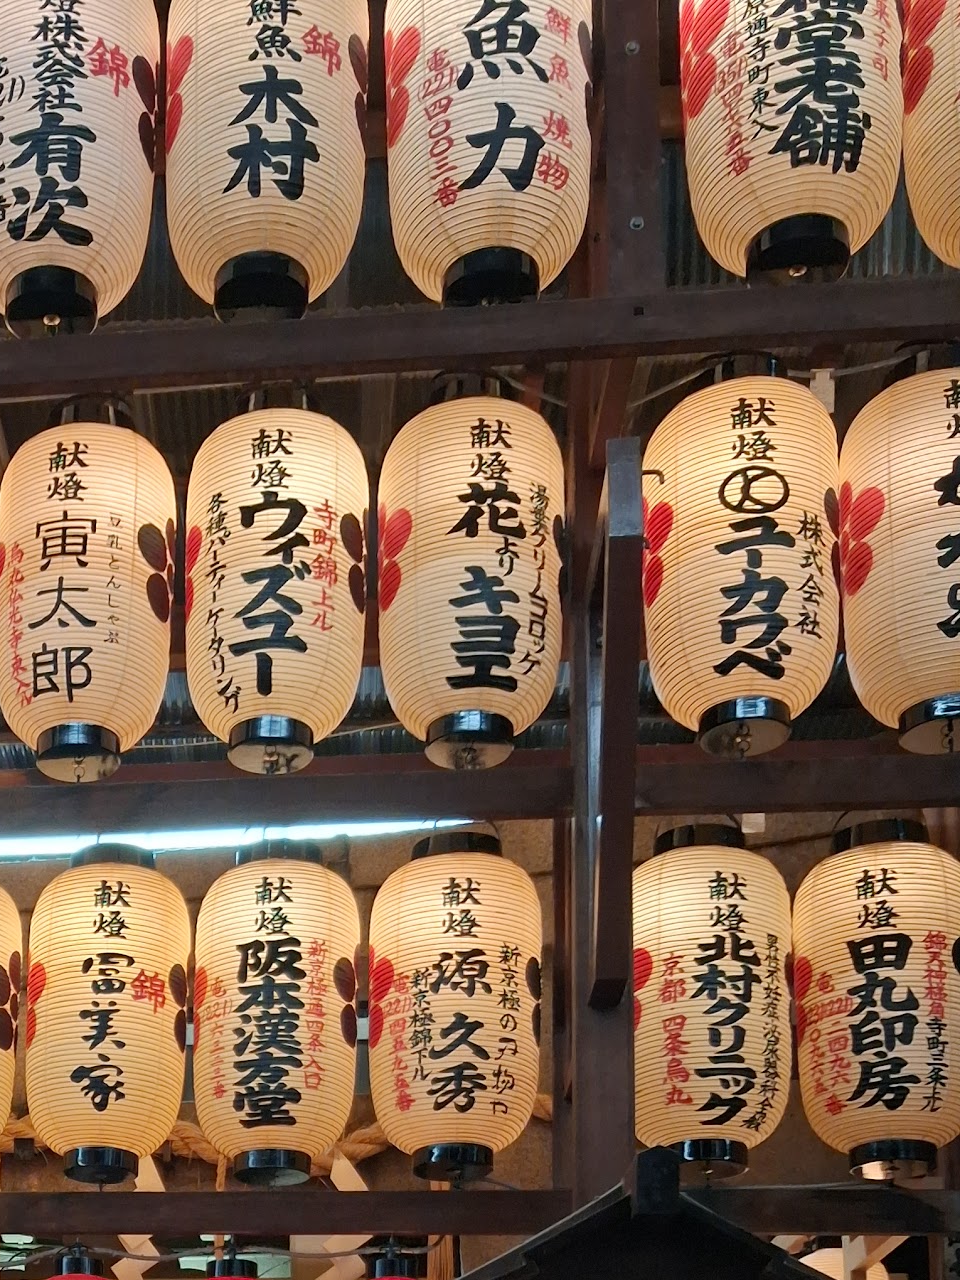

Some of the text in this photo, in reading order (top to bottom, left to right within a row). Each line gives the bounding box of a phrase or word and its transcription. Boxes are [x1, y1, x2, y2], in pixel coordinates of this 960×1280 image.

[29, 15, 89, 113] 株式会社
[84, 36, 132, 97] 錦
[300, 24, 343, 79] 錦
[457, 0, 551, 192] 魚力
[6, 113, 97, 248] 有次
[222, 64, 321, 201] 木村
[46, 441, 89, 502] 献燈
[250, 428, 294, 489] 献燈
[470, 417, 513, 483] 献燈
[730, 397, 779, 462] 献燈
[28, 510, 97, 703] 寅太郎
[103, 511, 123, 645] 豆乳とんしゃぶ
[204, 492, 241, 714] 各種パーティーケータリング
[228, 491, 311, 697] ウィズユー
[309, 498, 339, 633] 寺町錦上ル
[795, 510, 826, 640] 株式会社
[93, 879, 132, 939] 献燈
[255, 877, 294, 936] 献燈
[441, 877, 482, 939] 献燈
[708, 870, 750, 934] 献燈
[855, 868, 900, 930] 献燈
[130, 969, 167, 1015] 錦
[232, 936, 308, 1129] 阪本漢方堂
[408, 966, 436, 1082] 新京極錦下ル
[426, 948, 493, 1114] 源久秀
[690, 932, 762, 1126] 北村クリニック
[845, 933, 922, 1112] 田丸印房
